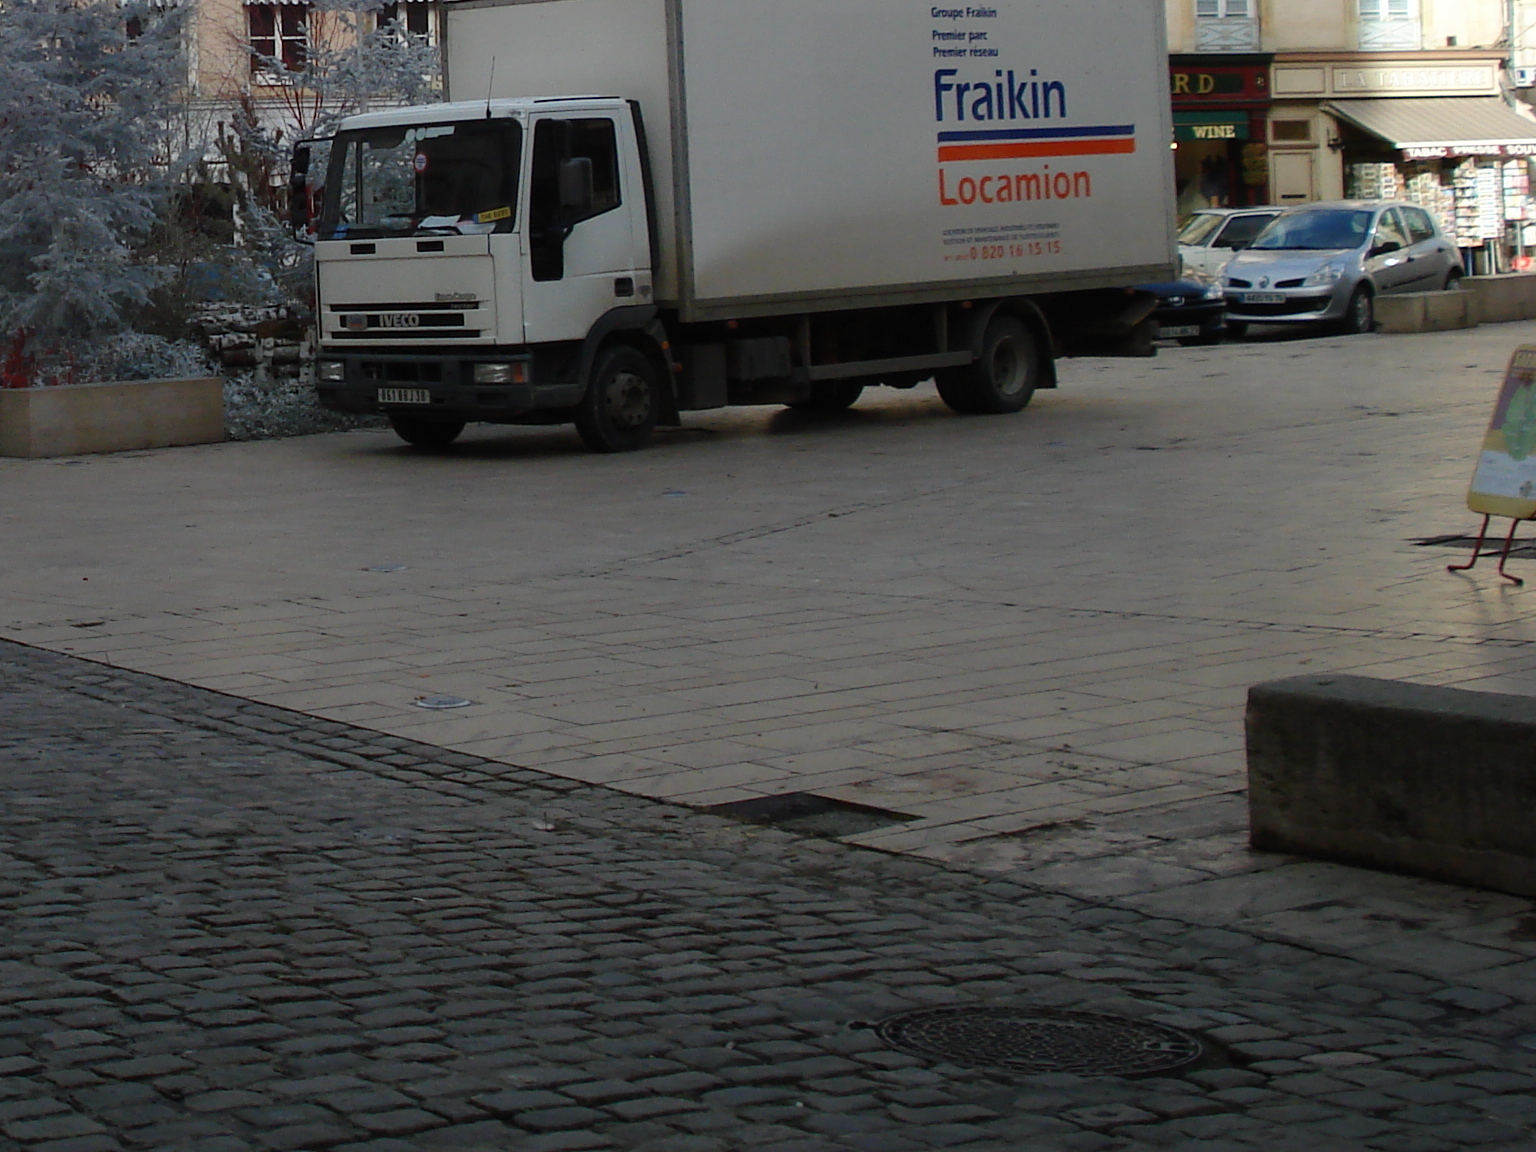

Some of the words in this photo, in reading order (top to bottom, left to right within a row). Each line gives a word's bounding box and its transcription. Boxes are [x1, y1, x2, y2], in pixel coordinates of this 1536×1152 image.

[931, 6, 964, 21] Groupe
[966, 6, 997, 18] Fraikin
[932, 30, 966, 41] Premier
[968, 31, 988, 43] parc
[933, 47, 967, 58] Premier
[969, 46, 999, 57] réseau
[1341, 71, 1367, 88] LA
[934, 68, 1067, 122] Fraikin
[1191, 124, 1236, 139] WINE
[1407, 146, 1448, 159] TABAC
[938, 164, 1092, 206] Locamion
[981, 245, 1005, 260] 820
[1009, 243, 1023, 258] 16
[1028, 241, 1042, 256] 15
[1047, 240, 1061, 254] 15
[379, 313, 420, 328] IVECO
